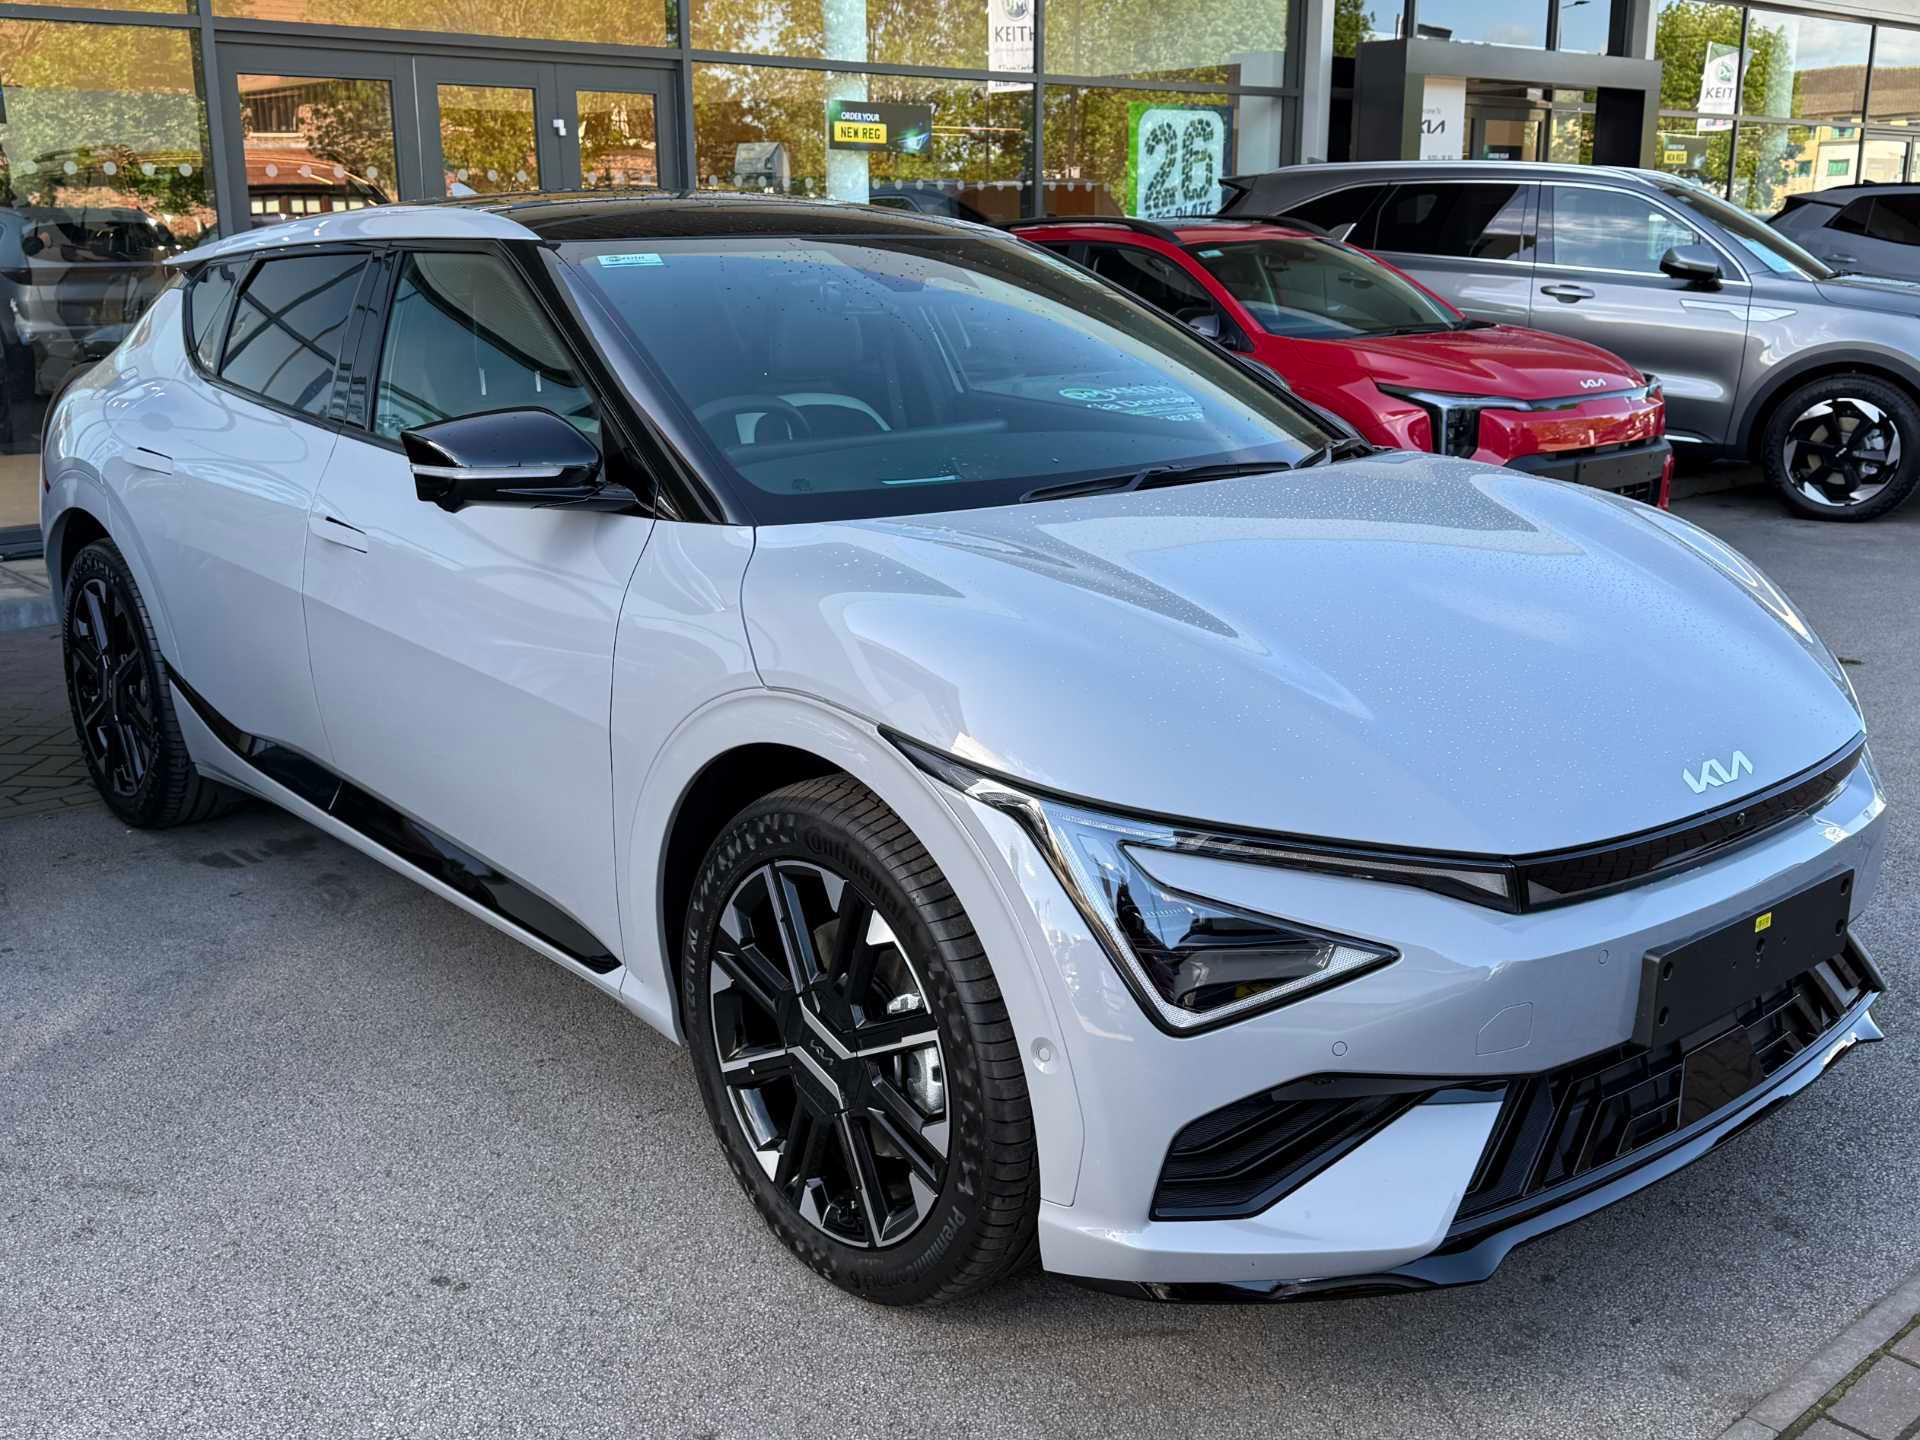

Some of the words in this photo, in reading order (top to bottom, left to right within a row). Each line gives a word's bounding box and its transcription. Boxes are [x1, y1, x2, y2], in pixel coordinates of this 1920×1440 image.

[1705, 86, 1735, 99] KEIT
[841, 111, 862, 121] ORDER
[863, 113, 880, 122] YOUR
[840, 126, 859, 139] NEW
[862, 128, 880, 140] REG
[1144, 119, 1214, 212] 26
[1683, 750, 1753, 794] KIA
